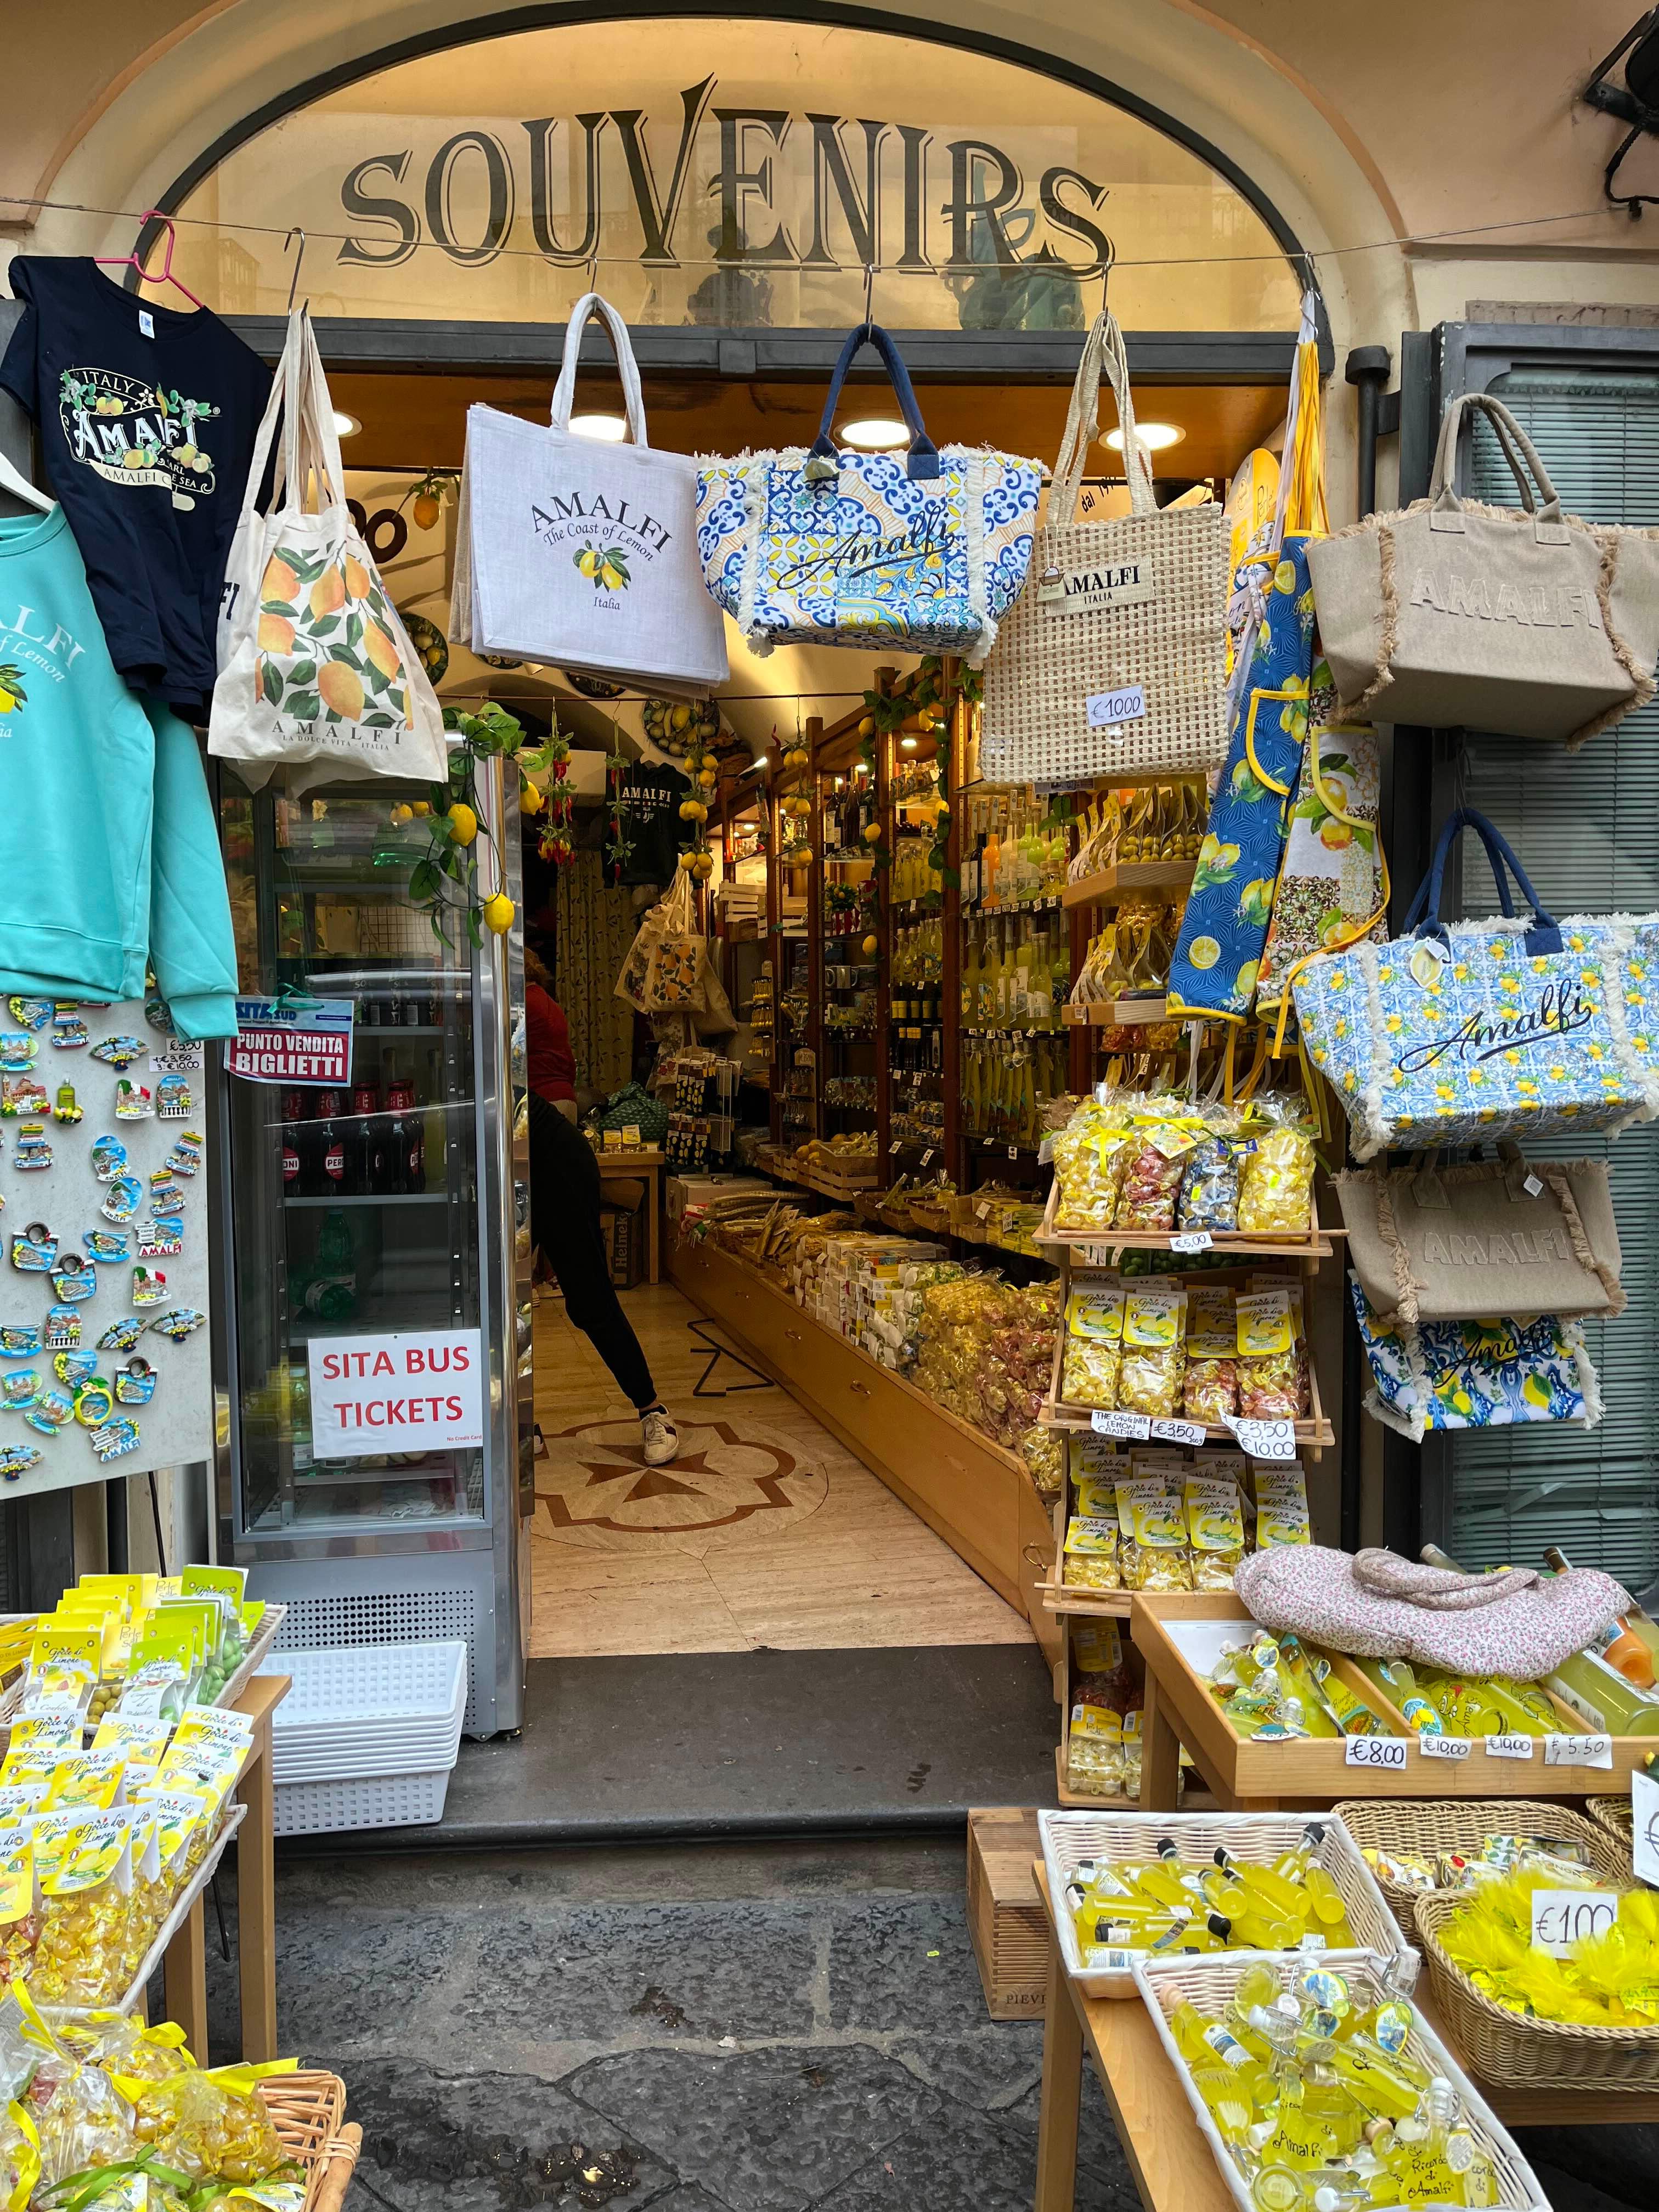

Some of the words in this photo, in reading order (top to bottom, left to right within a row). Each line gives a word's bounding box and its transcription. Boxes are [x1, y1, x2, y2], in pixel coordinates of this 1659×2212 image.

[337, 72, 1114, 281] SOUVENIRS
[83, 371, 135, 394] ITALY
[104, 468, 156, 483] AMALFI
[531, 491, 673, 554] AMALFI
[543, 527, 565, 546] The
[567, 523, 599, 538] Coast
[602, 524, 618, 540] of
[617, 531, 654, 561] Lemon
[776, 505, 955, 590] Amalfi
[593, 596, 621, 610] Italia
[1084, 591, 1113, 605] ITALIA
[1410, 569, 1600, 628] AMALFI
[0, 604, 86, 672] LFI
[11, 641, 65, 683] Lemon
[272, 720, 401, 744] AMALFI
[298, 735, 326, 744] DOLCE
[331, 739, 351, 747] VITA
[274, 1010, 297, 1020] SUD
[1398, 978, 1593, 1073] Amalfi
[236, 1033, 282, 1051] PUNTO
[286, 1035, 343, 1054] VENDITA
[236, 1053, 343, 1076] BIGLIETTI
[105, 1172, 127, 1181] AMALFI
[105, 1211, 126, 1221] AMALFI
[141, 1244, 182, 1257] AMALFI
[1424, 1228, 1570, 1265] AMALFI
[323, 1351, 396, 1380] SITA
[406, 1346, 470, 1374] BUS
[333, 1395, 463, 1428] TICKETS
[1096, 1411, 1111, 1421] THE
[1113, 1413, 1149, 1425] ORIGINAL
[1098, 1425, 1144, 1439] CANDIES
[1107, 1420, 1136, 1430] LEMON
[1154, 1421, 1195, 1438] €3,50
[1235, 1419, 1289, 1441] €3,50
[1241, 1437, 1295, 1458] €10,00
[49, 1647, 73, 1657] Gocce
[74, 1646, 83, 1655] di
[33, 1718, 62, 1730] Gocce
[64, 1713, 75, 1724] di
[36, 1727, 71, 1737] Limone
[200, 1725, 229, 1739] Gocce
[229, 1733, 240, 1743] di
[25, 1757, 56, 1765] Limon
[72, 1758, 100, 1770] Gocce
[101, 1752, 112, 1763] di
[180, 1752, 210, 1765] Gocce
[212, 1757, 224, 1769] di
[83, 1821, 109, 1838] Gocce
[111, 1814, 120, 1826] di
[157, 1813, 182, 1822] imone
[1272, 2130, 1323, 2157] Amalfi
[1425, 2170, 1437, 2181] di
[1408, 2181, 1455, 2199] Amalfi
